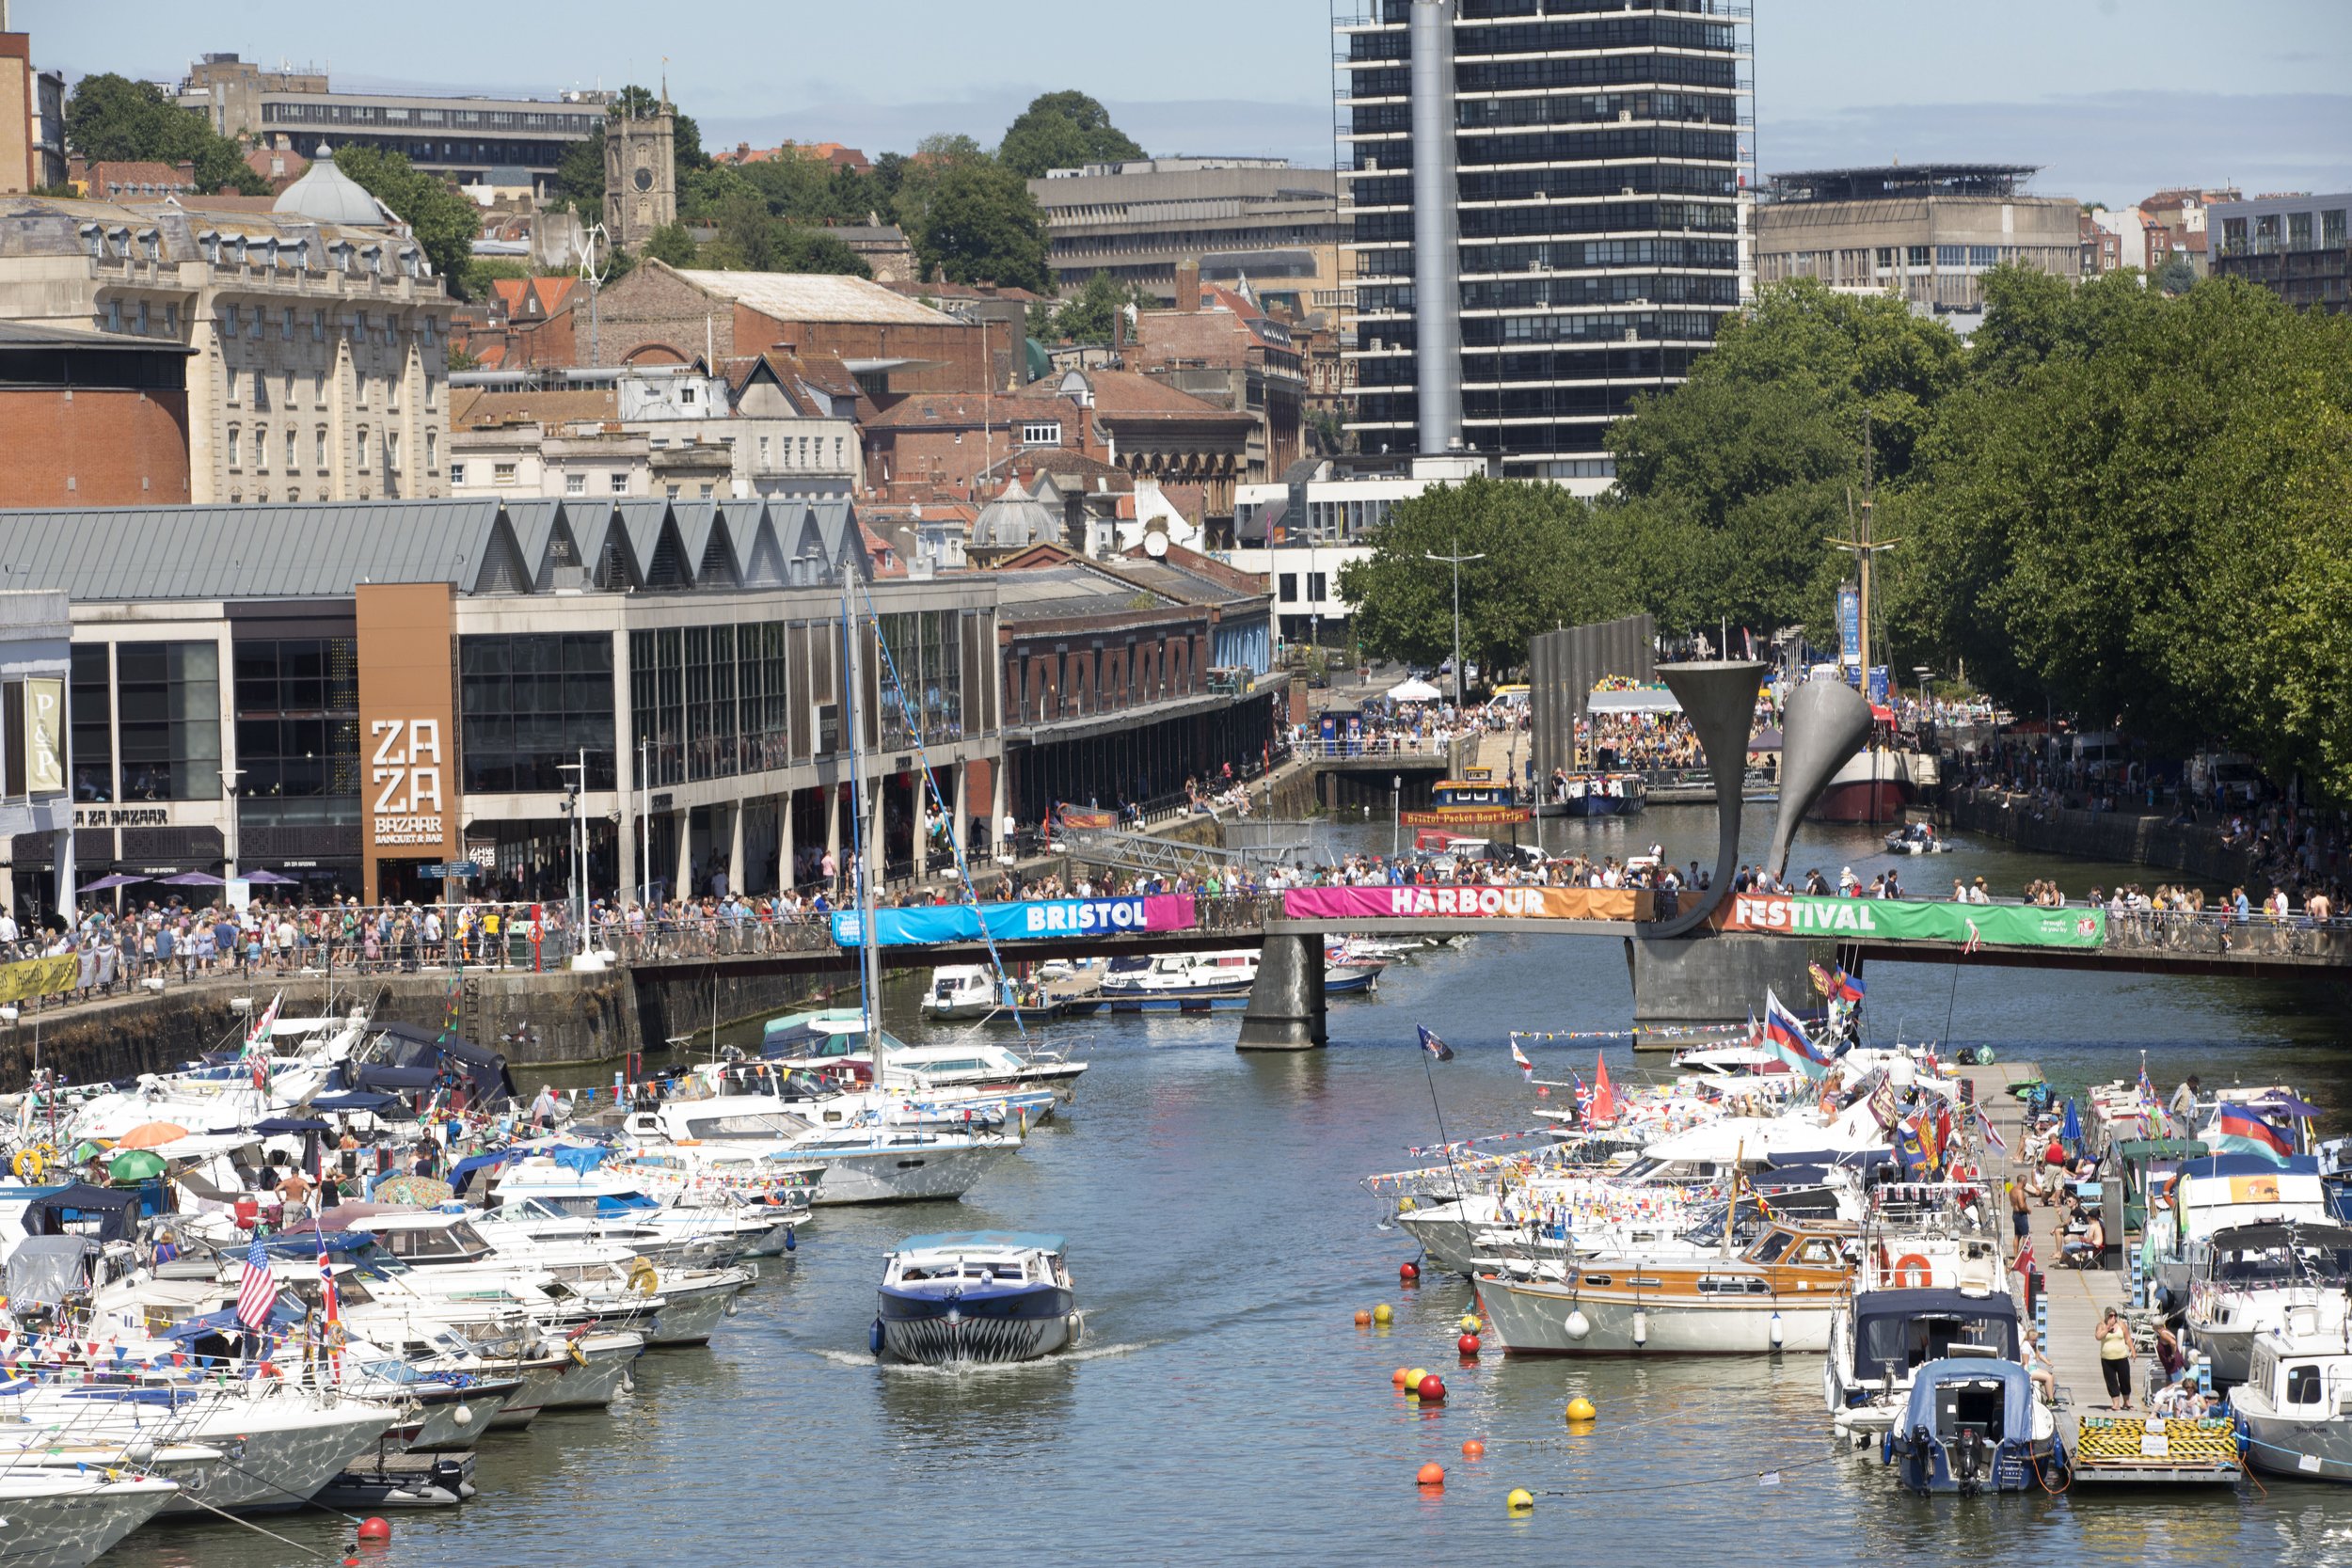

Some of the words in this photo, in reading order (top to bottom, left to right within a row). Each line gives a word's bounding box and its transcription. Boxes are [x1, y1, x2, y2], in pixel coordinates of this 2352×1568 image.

[36, 693, 55, 720] P
[372, 719, 441, 765] ZA
[36, 750, 55, 777] P
[373, 767, 442, 814] ZA
[88, 809, 107, 827] ZA
[111, 809, 168, 826] BAZAAR
[374, 816, 443, 833] BAZAAR
[1407, 813, 1439, 823] Bristol
[1443, 813, 1473, 823] Packet
[1476, 812, 1498, 822] Boat
[1502, 811, 1524, 822] Trips
[375, 834, 416, 845] BANQUET
[417, 833, 424, 844] &
[425, 833, 443, 844] BAR
[1391, 888, 1546, 914] HARBOUR
[1736, 899, 1876, 930] FESTIVAL
[1026, 902, 1148, 931] BRISTOL
